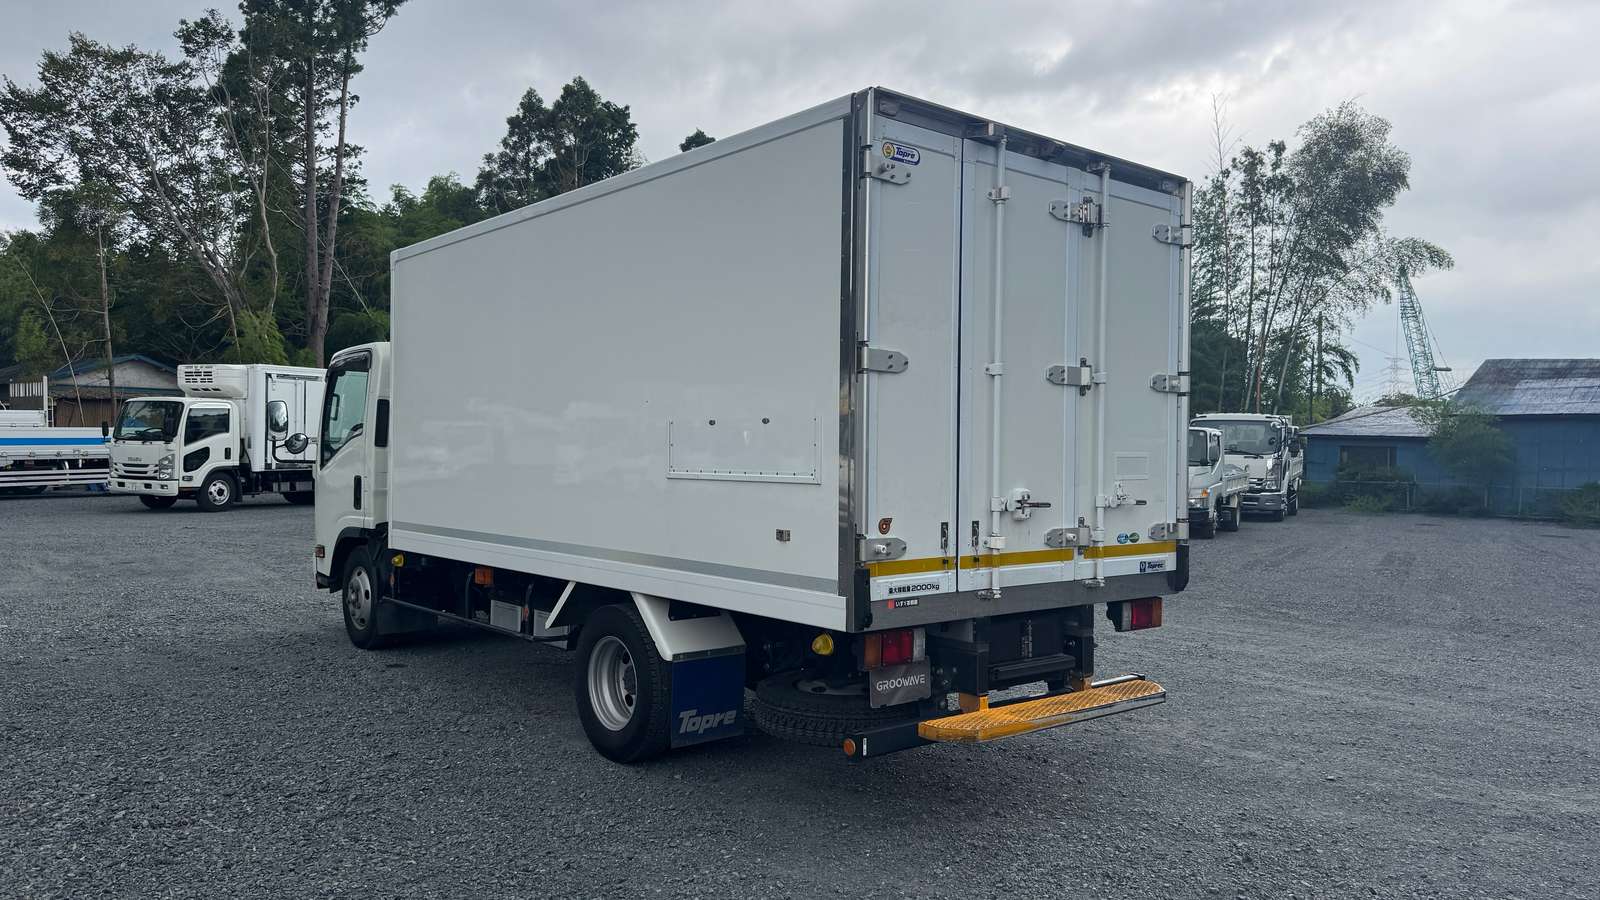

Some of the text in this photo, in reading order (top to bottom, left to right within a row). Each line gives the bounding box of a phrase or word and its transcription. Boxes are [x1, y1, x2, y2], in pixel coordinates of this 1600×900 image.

[895, 146, 916, 159] Topre
[876, 674, 926, 691] GROOWAVE
[679, 709, 737, 734] Topre
